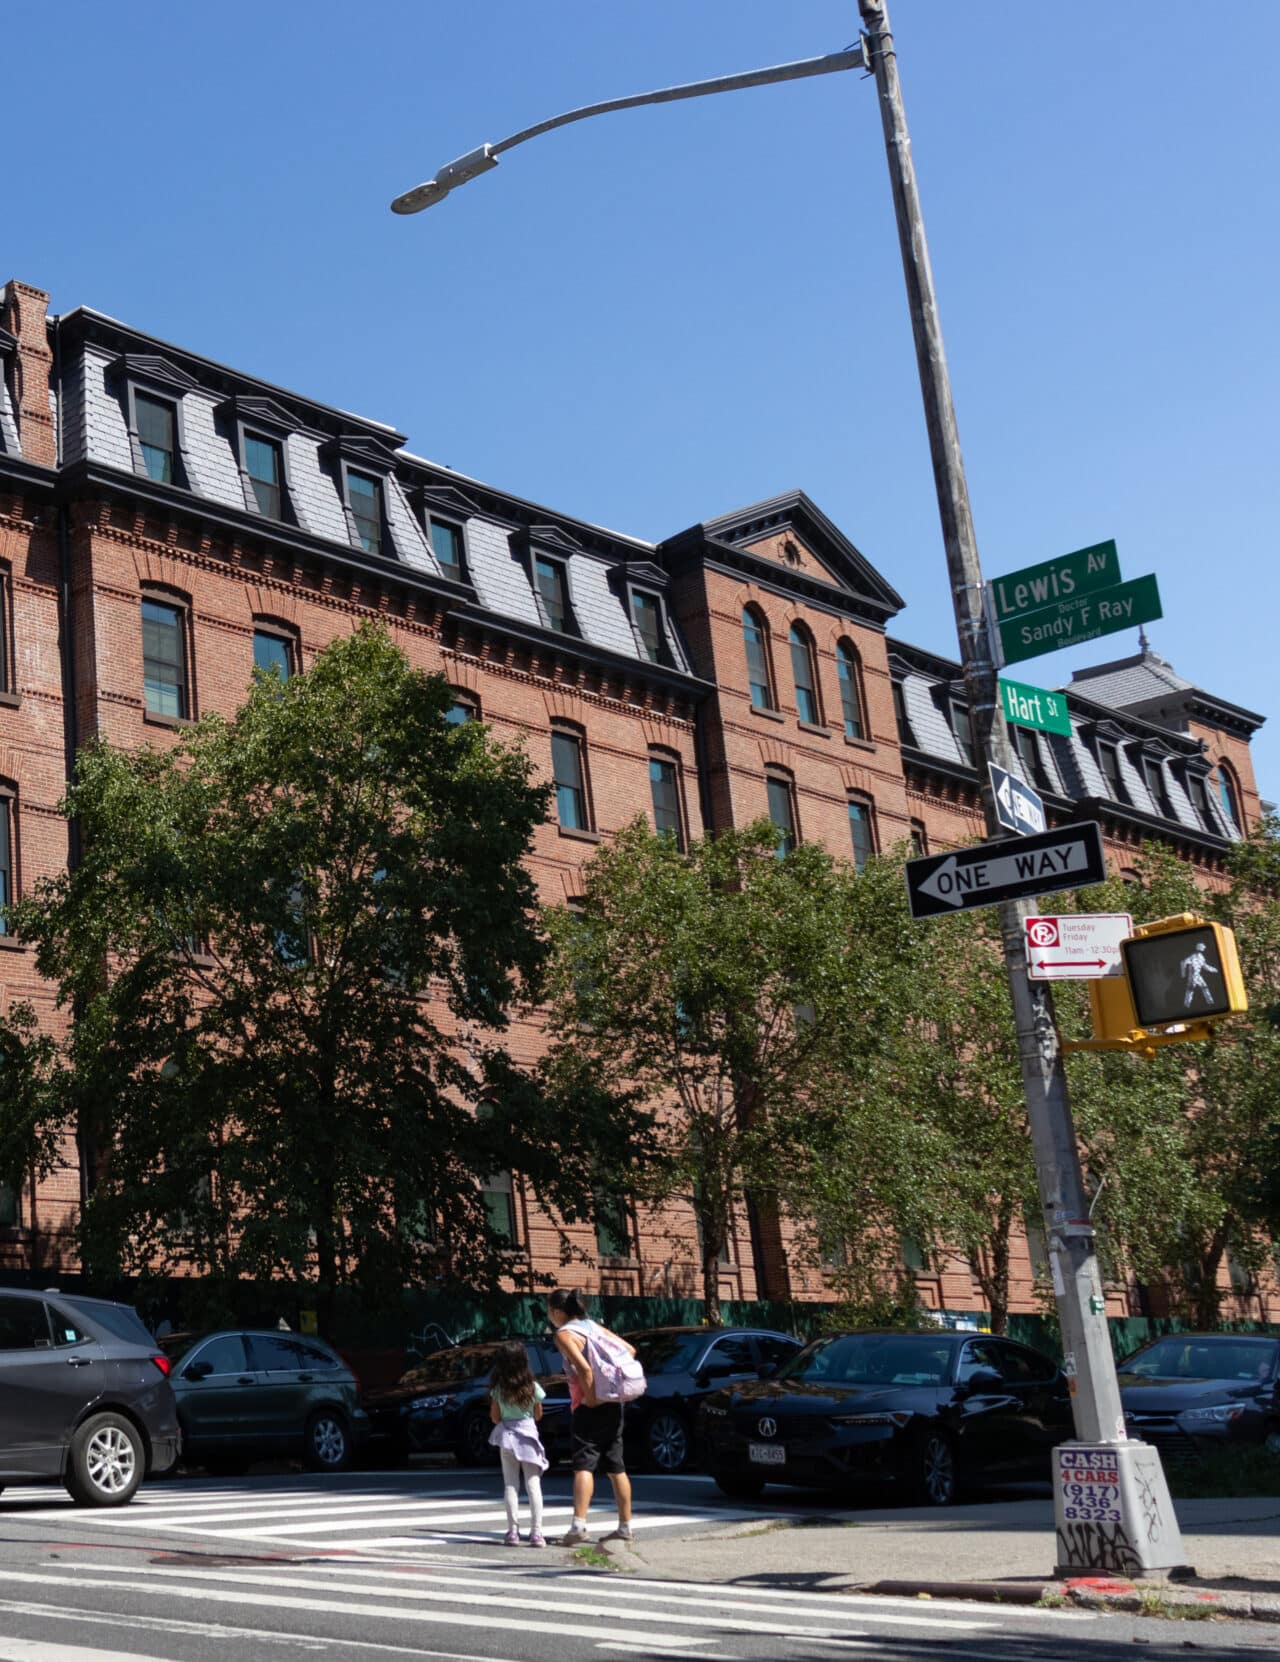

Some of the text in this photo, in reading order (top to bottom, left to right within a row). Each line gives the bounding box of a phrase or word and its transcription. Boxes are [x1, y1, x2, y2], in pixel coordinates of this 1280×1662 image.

[998, 553, 1107, 613] Lewis Av
[1058, 599, 1088, 613] Doctor
[1021, 598, 1133, 644] Sandy F Ray
[1007, 686, 1059, 724] Hart St
[937, 846, 1073, 894] ONE WAY
[1063, 923, 1095, 932] Tuesday
[1063, 933, 1088, 942] Friday
[1065, 946, 1085, 954] 11am
[1061, 1471, 1118, 1483] 4 CARS
[1063, 1484, 1119, 1500] (917)
[1071, 1497, 1111, 1509] 436
[1065, 1507, 1121, 1521] 8323
